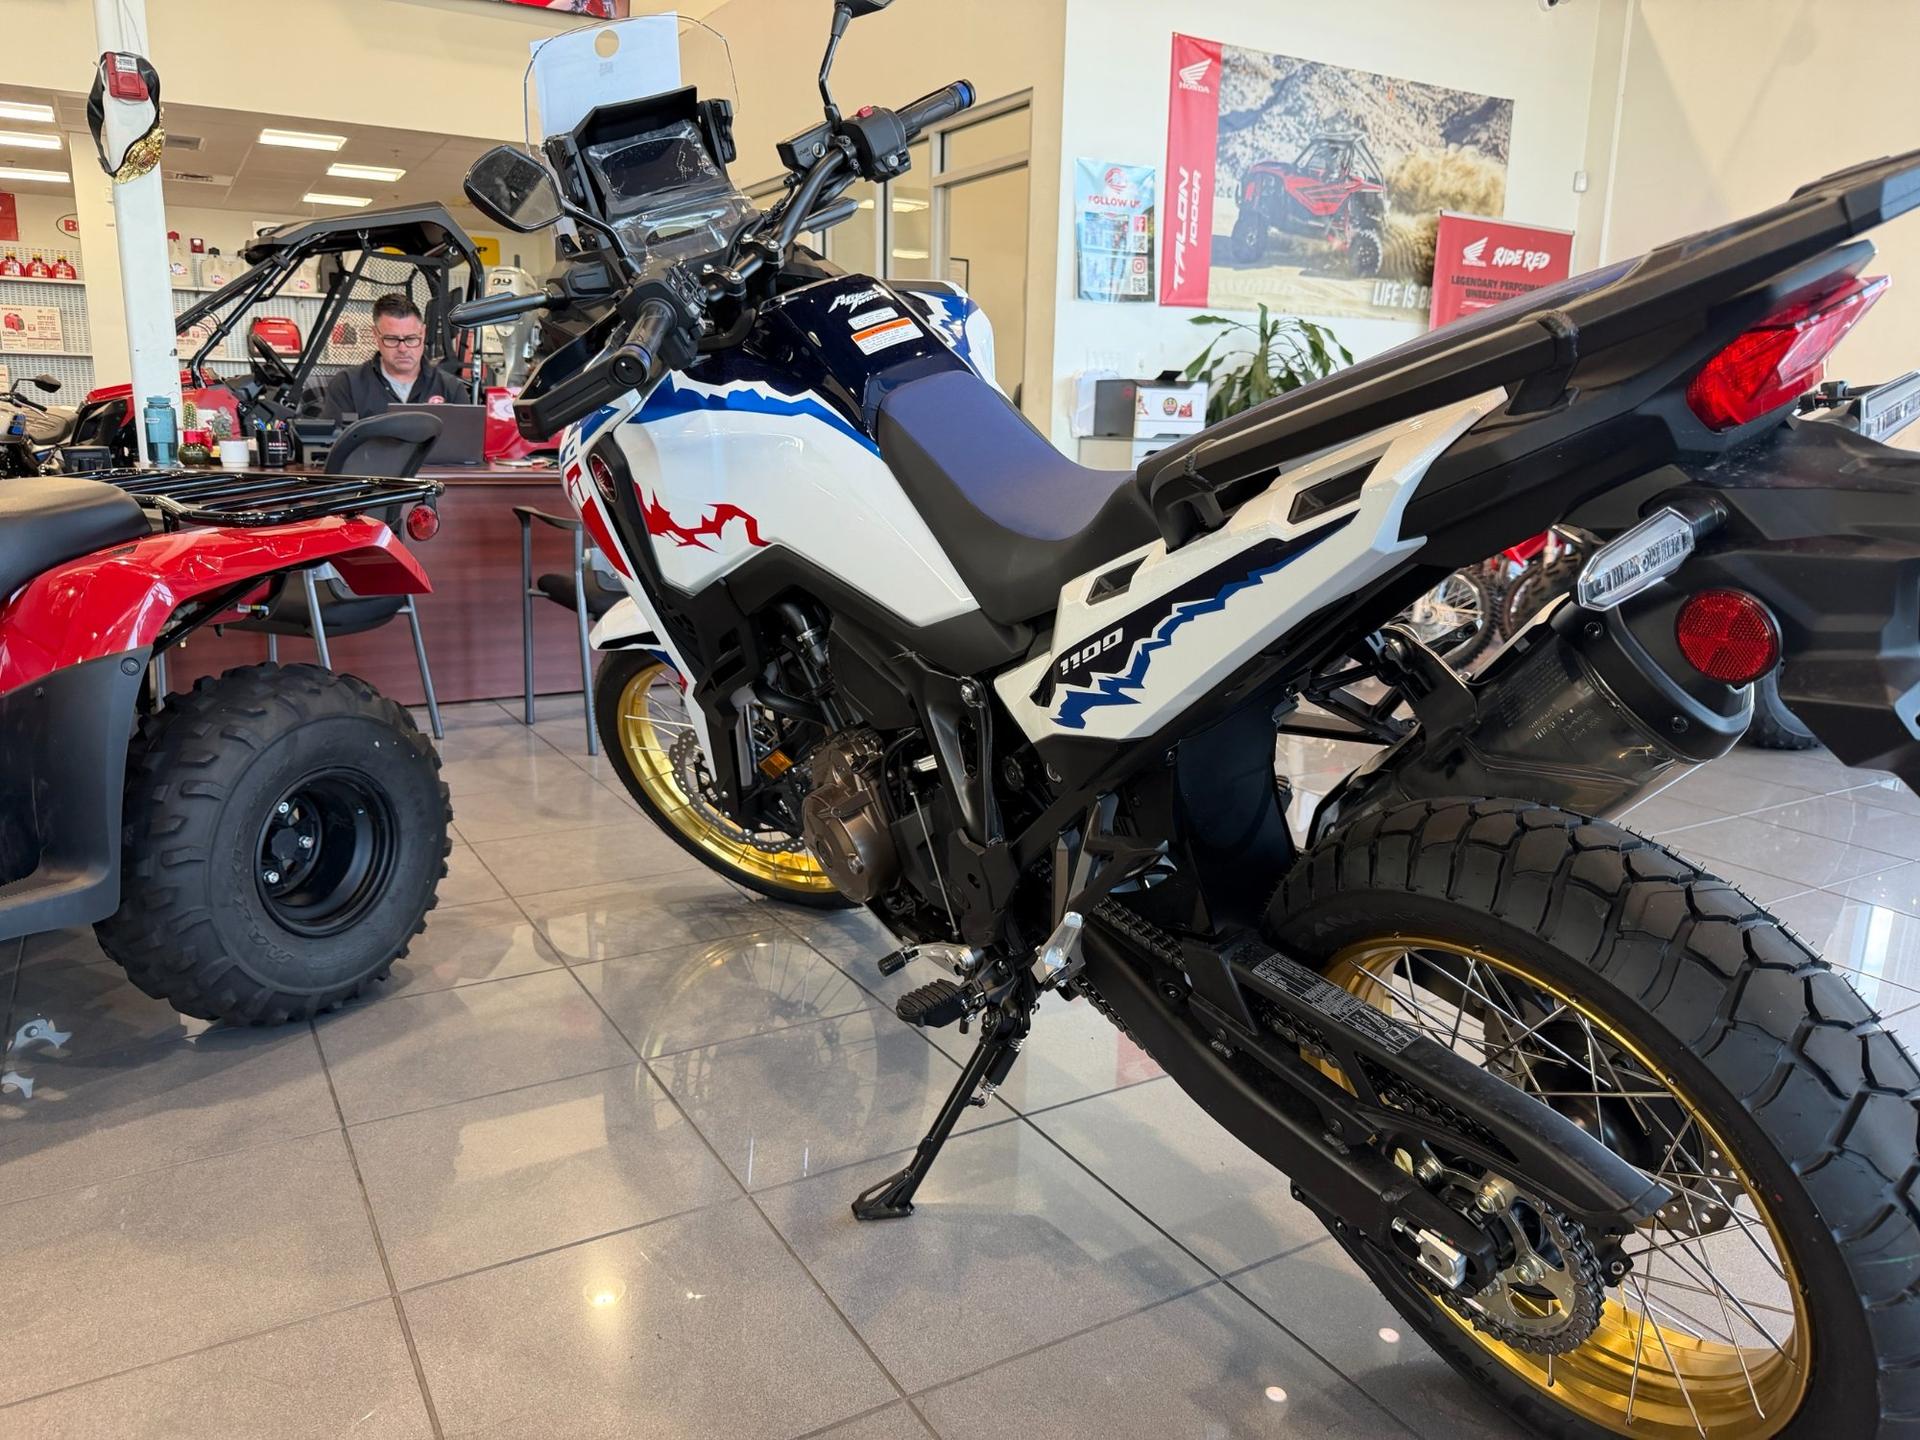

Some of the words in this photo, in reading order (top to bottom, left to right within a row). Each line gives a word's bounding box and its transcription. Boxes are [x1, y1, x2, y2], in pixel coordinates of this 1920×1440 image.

[1179, 81, 1210, 94] HONDA
[1088, 195, 1127, 207] FOLLOW
[1190, 170, 1201, 247] 1000R
[1173, 166, 1189, 291] TALON
[1491, 247, 1525, 268] RIDE
[1522, 251, 1551, 273] RED
[1373, 282, 1400, 306] LIFE
[1402, 283, 1418, 309] IS
[1060, 627, 1124, 676] 1100
